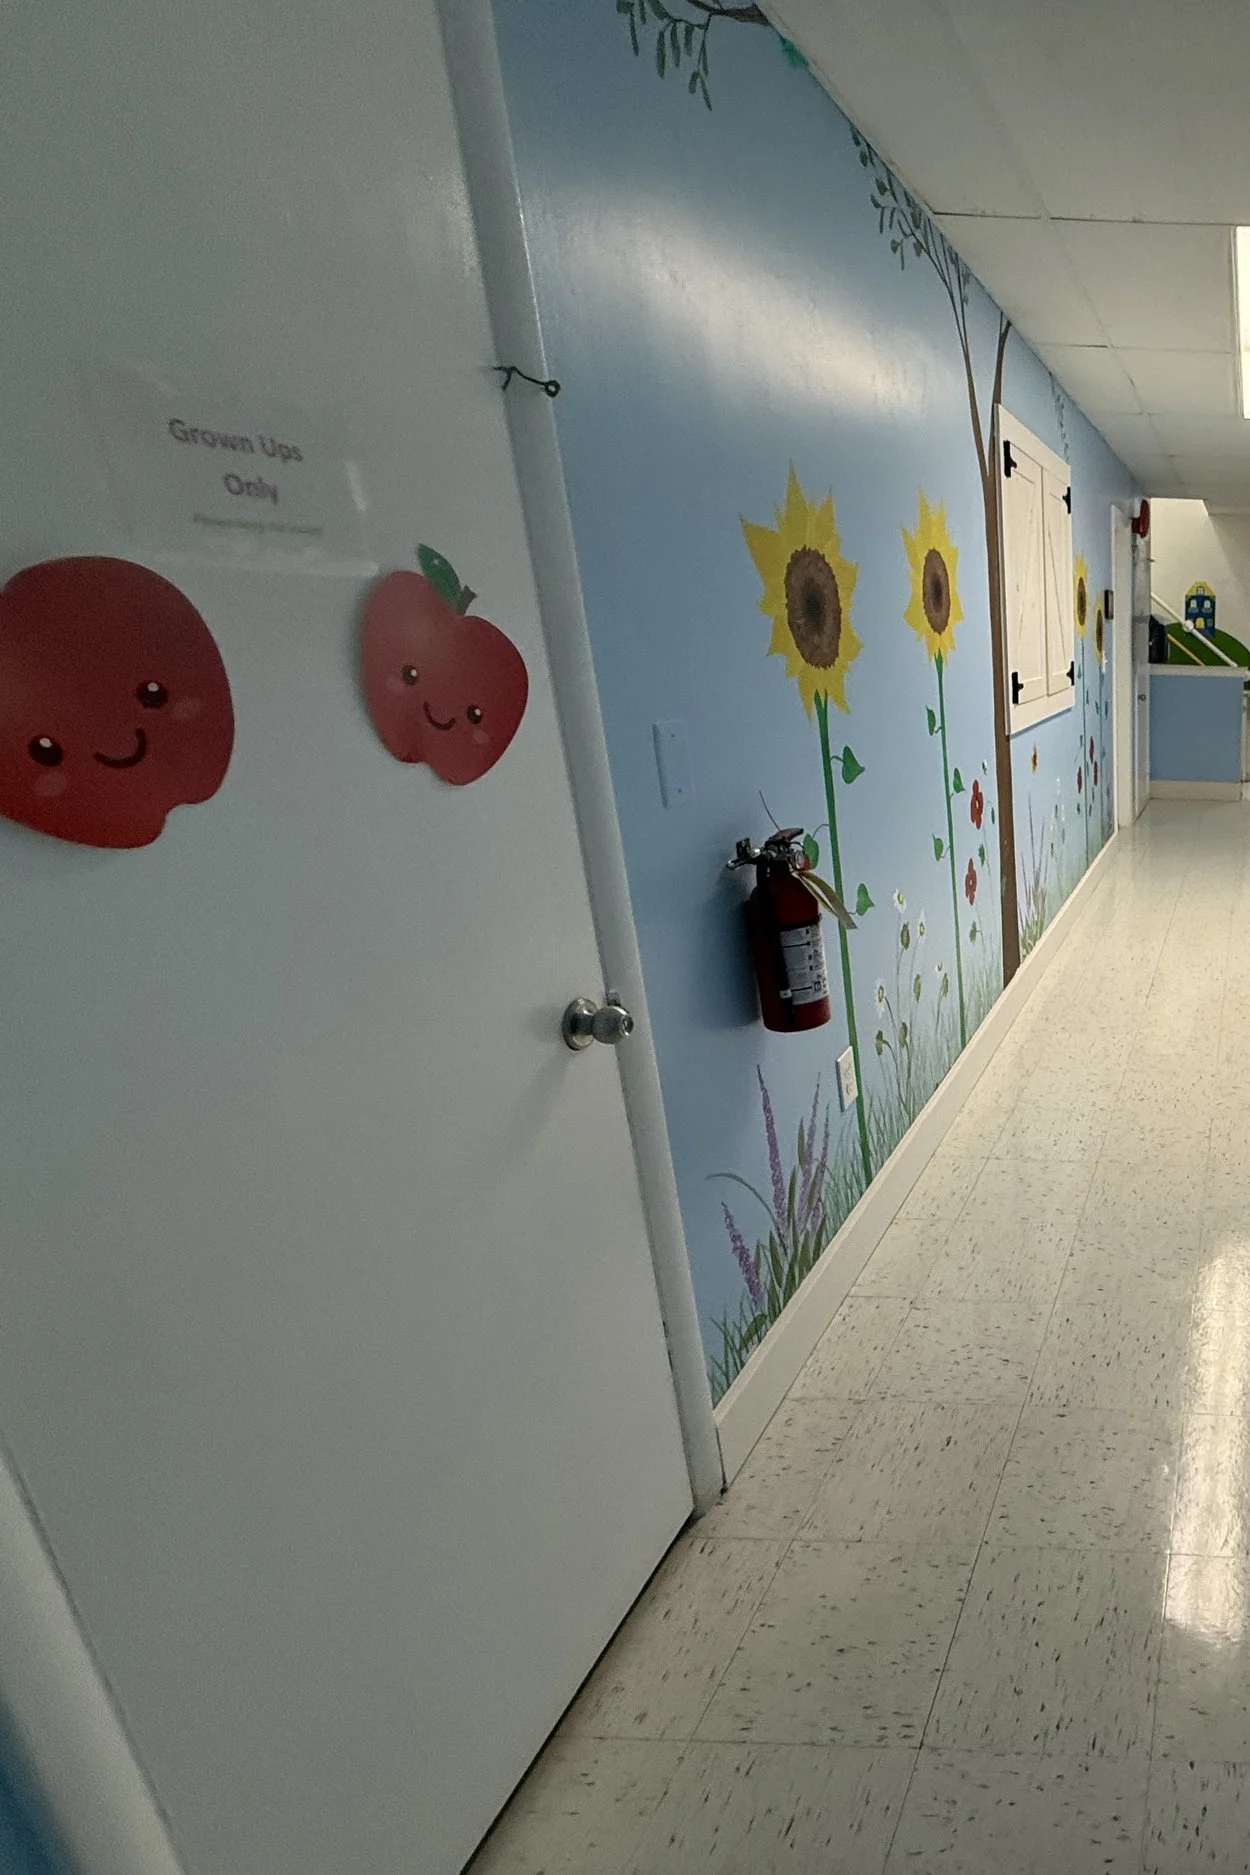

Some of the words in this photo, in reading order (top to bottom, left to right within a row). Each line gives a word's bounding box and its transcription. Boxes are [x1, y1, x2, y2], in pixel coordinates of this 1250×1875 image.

[168, 418, 255, 454] Grown
[259, 434, 304, 462] Ups
[223, 473, 280, 506] Only
